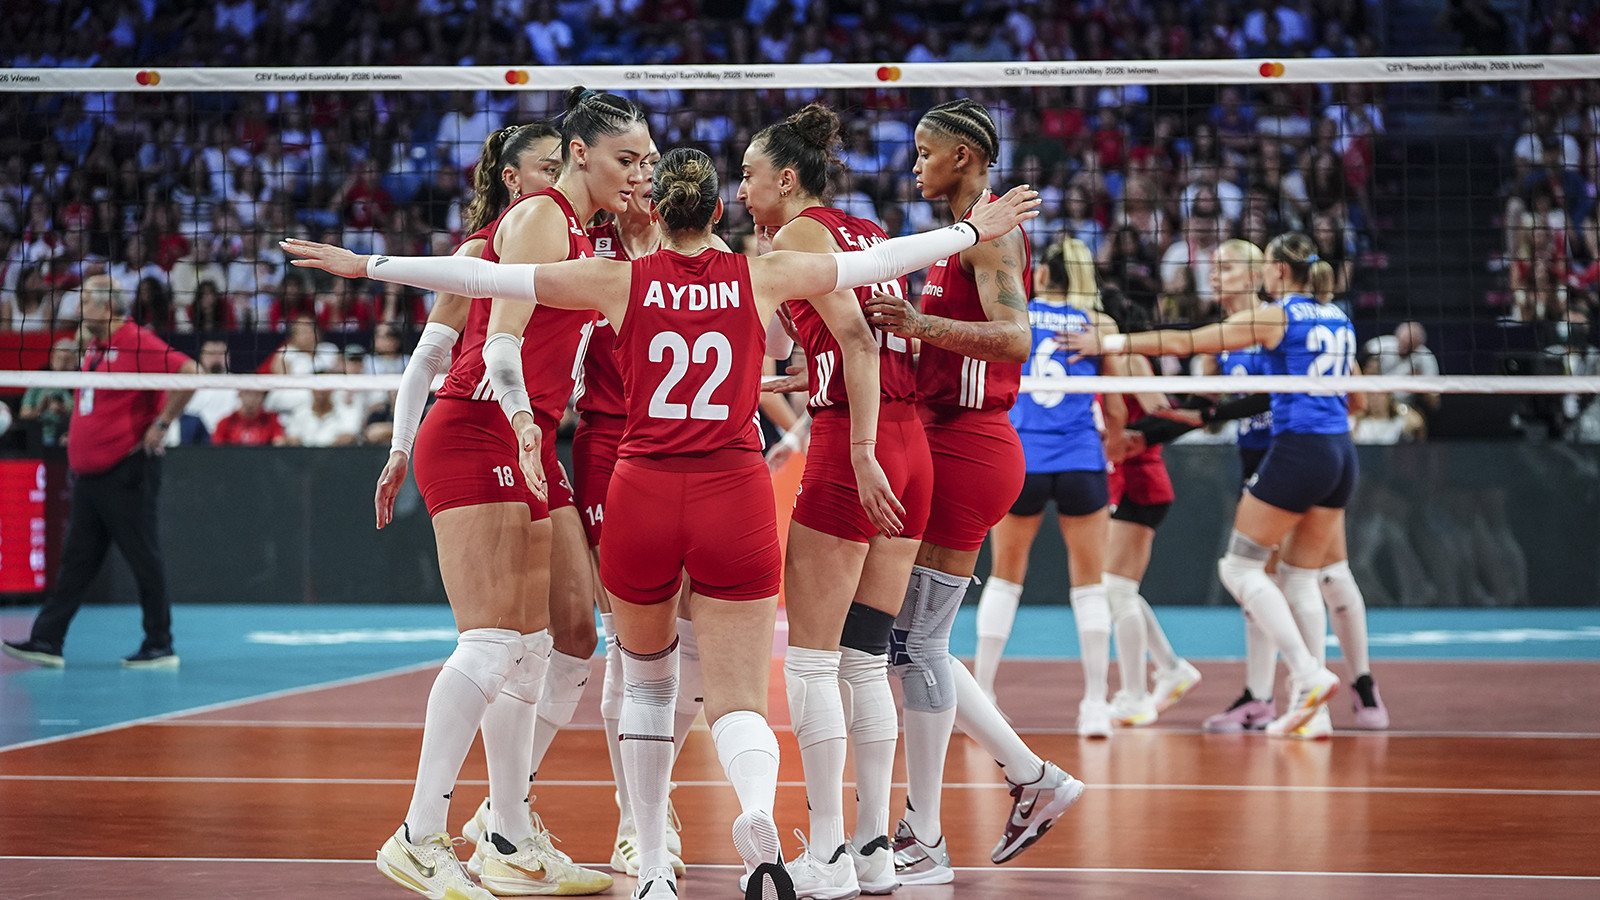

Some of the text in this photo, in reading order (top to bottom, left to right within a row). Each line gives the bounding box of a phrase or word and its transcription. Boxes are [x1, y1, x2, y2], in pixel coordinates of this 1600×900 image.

[624, 71, 641, 80] CEV
[644, 71, 677, 81] Trendyol
[680, 71, 721, 81] EuroVolley
[745, 71, 775, 79] Women
[1004, 67, 1022, 76] CEV
[1024, 67, 1058, 77] Trendyol
[1060, 67, 1102, 77] EuroVolley
[1127, 67, 1159, 75] Women
[1386, 62, 1545, 73] CEV Trendyol EuroVolley 2026 Women
[10, 73, 41, 82] Women
[255, 72, 402, 83] CEV Trendyol EuroVolley 2026 Women
[643, 280, 740, 311] AYDIN
[648, 331, 733, 421] 22
[1029, 336, 1068, 409] 6
[492, 465, 515, 488] 18
[586, 503, 604, 527] 14
